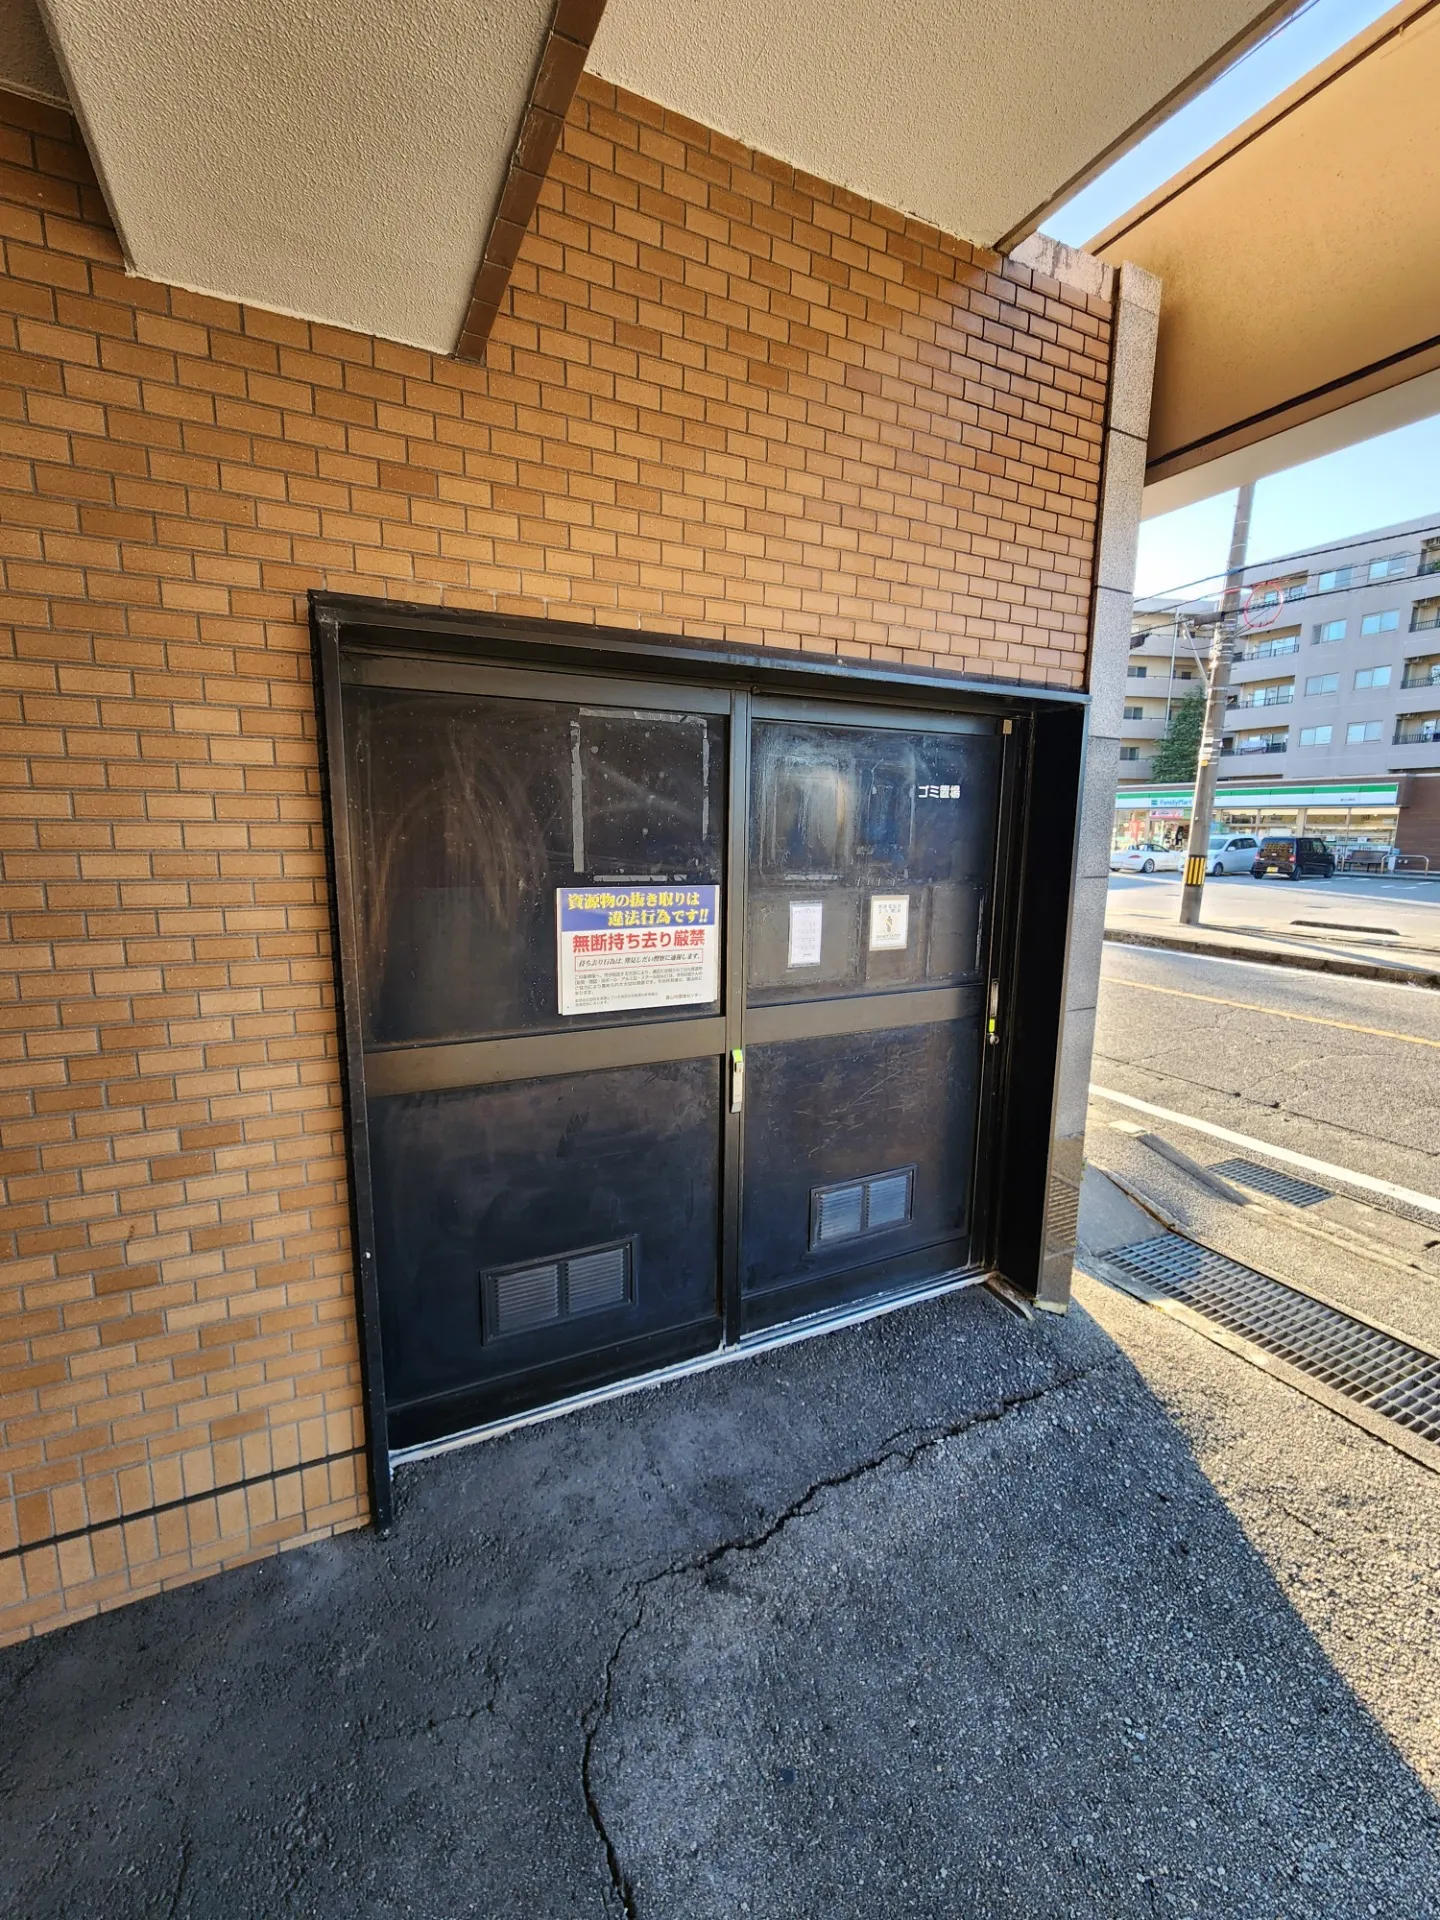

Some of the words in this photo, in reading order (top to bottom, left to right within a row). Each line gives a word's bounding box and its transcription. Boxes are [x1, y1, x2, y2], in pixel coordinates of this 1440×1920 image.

[568, 892, 700, 910] 資源物の抜き取りは
[573, 929, 705, 953] 無断持ち去り厳禁
